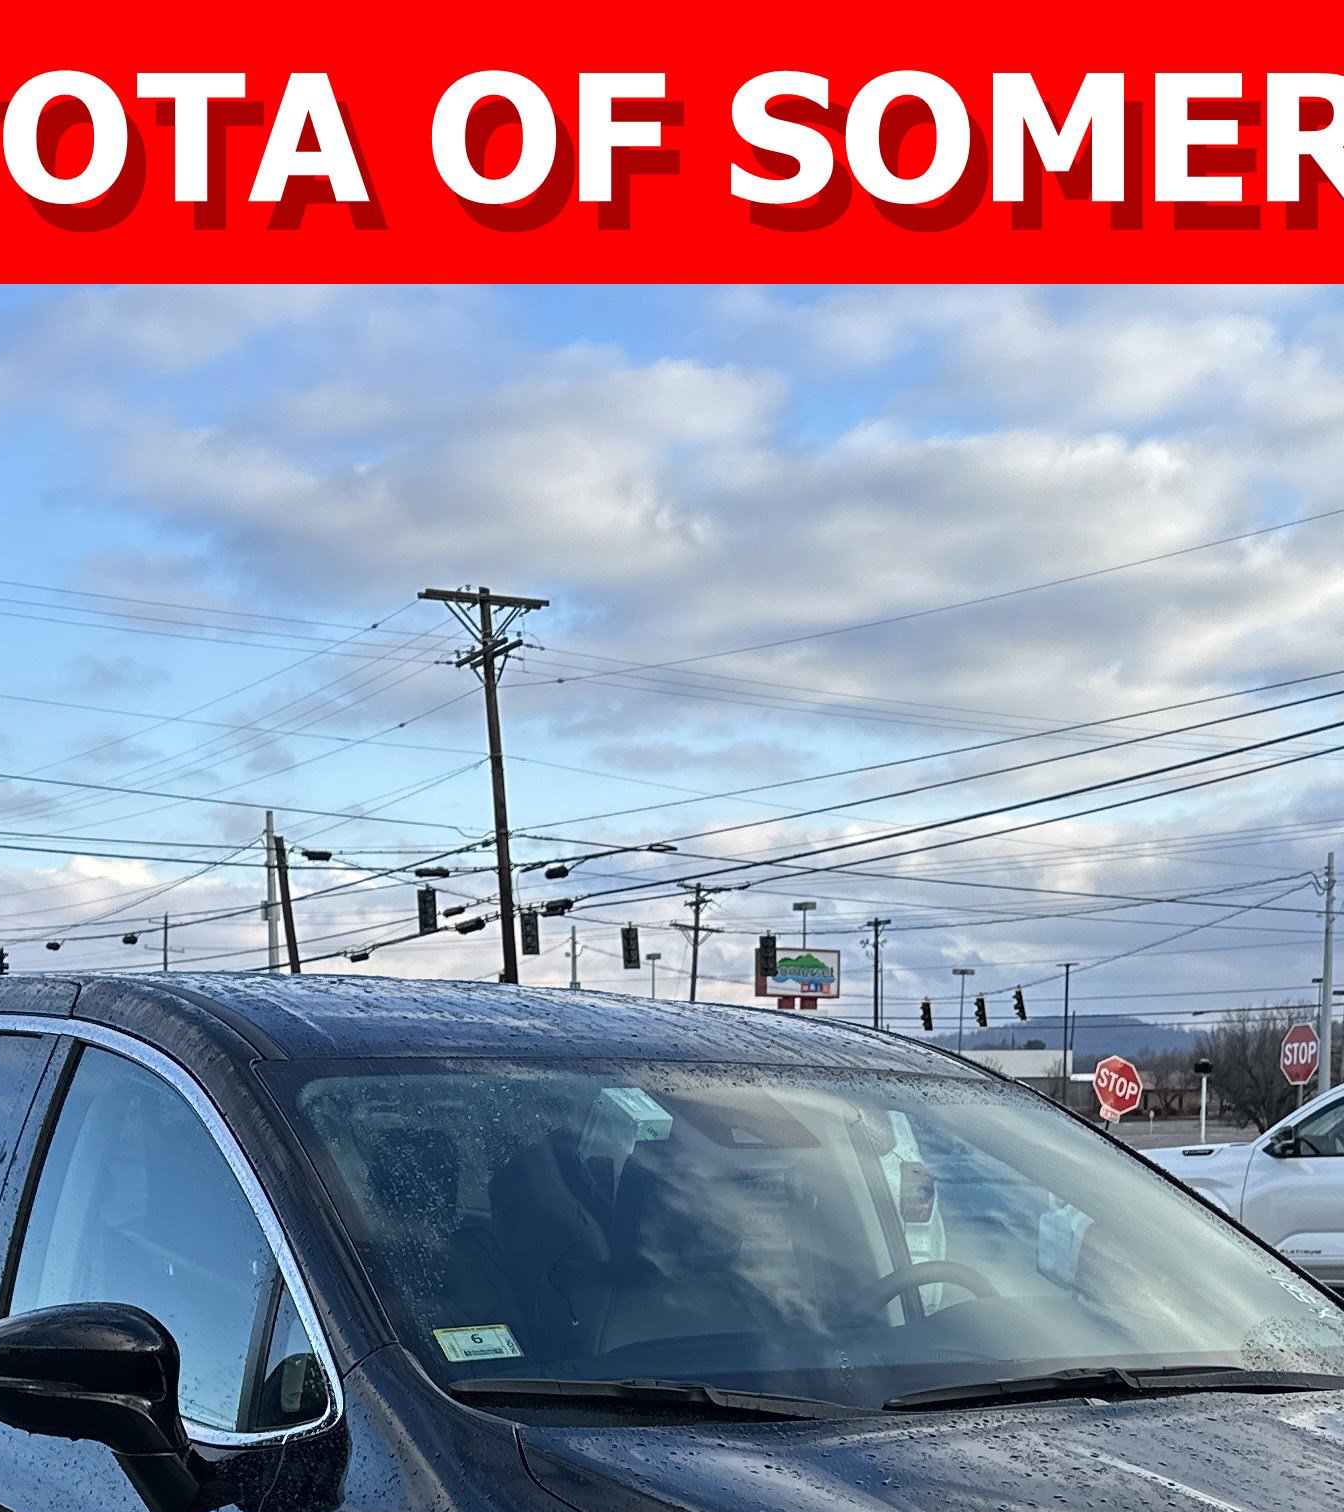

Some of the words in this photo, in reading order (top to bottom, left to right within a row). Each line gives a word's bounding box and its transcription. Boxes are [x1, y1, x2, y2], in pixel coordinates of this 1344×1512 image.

[1284, 1041, 1317, 1066] STOP
[1097, 1067, 1139, 1101] STOP
[470, 1333, 484, 1344] 6
